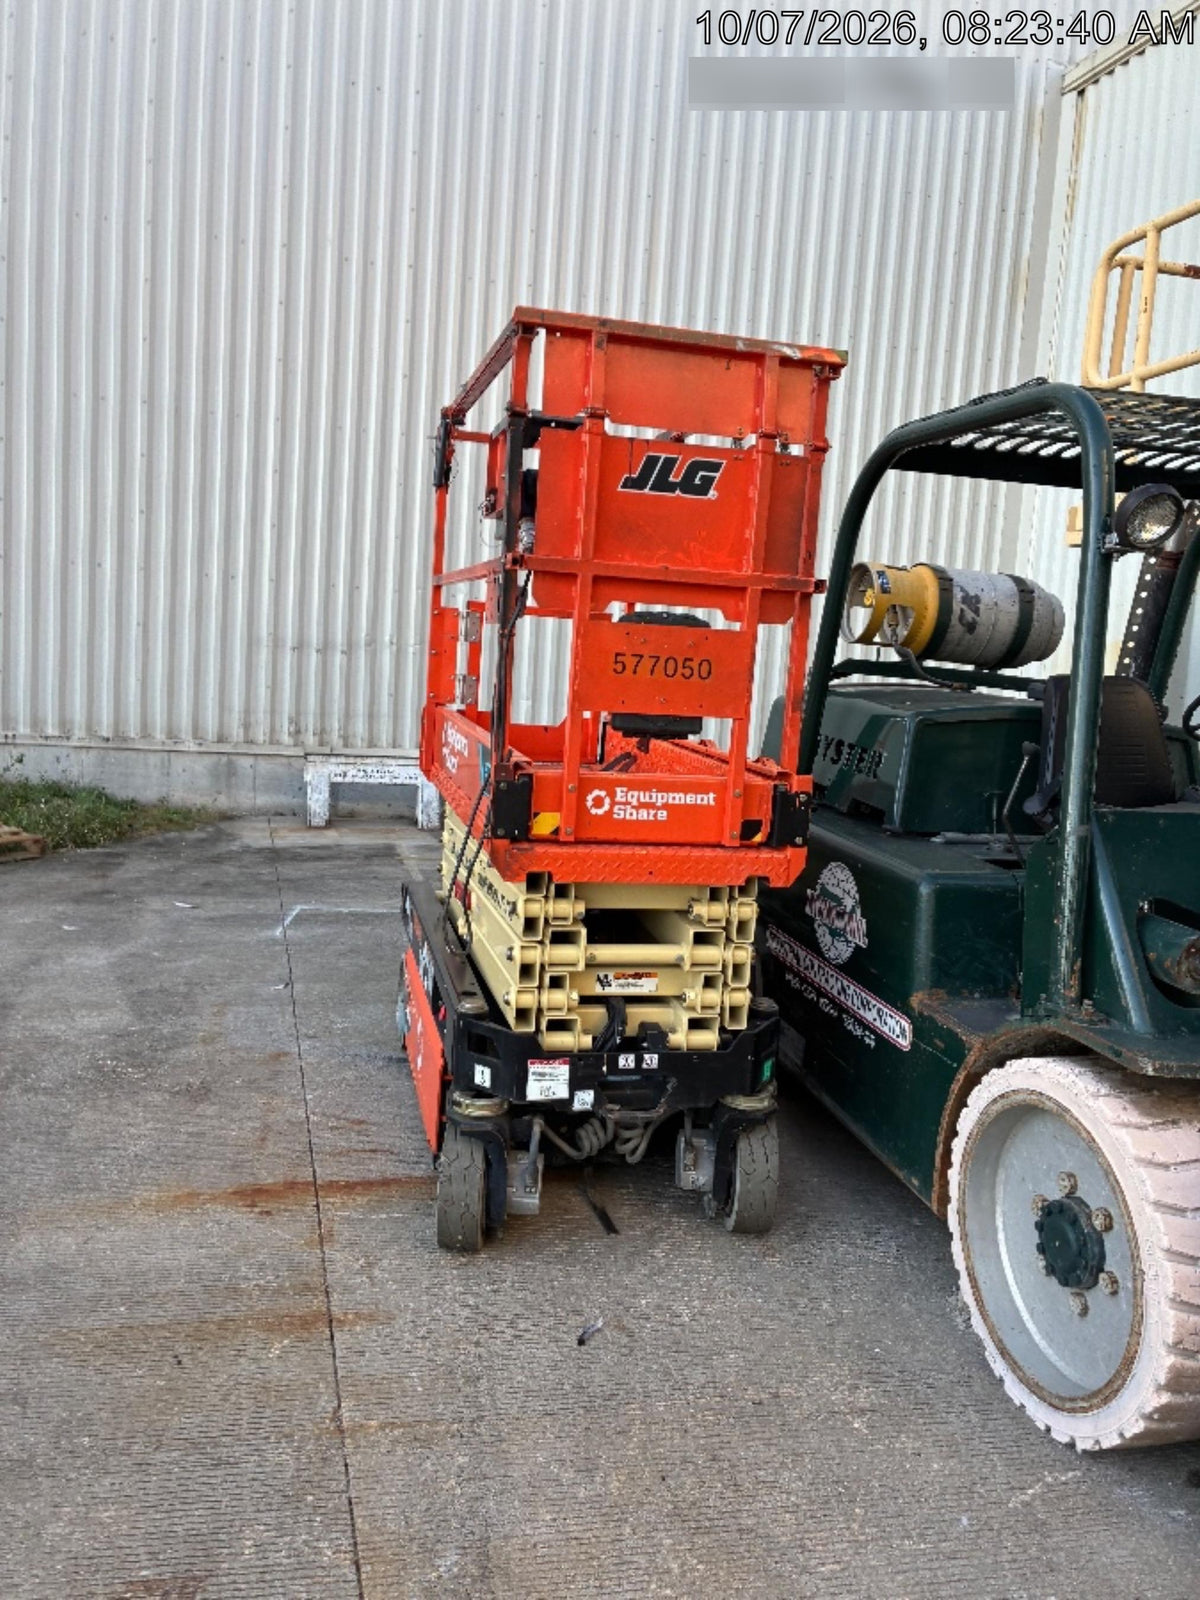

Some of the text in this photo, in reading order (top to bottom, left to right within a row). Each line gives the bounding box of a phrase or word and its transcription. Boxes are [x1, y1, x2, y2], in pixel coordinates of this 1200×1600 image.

[617, 452, 726, 498] JLG
[612, 652, 712, 680] 577050
[817, 734, 884, 780] YSTER
[614, 786, 717, 806] Equipment
[612, 804, 668, 821] Share
